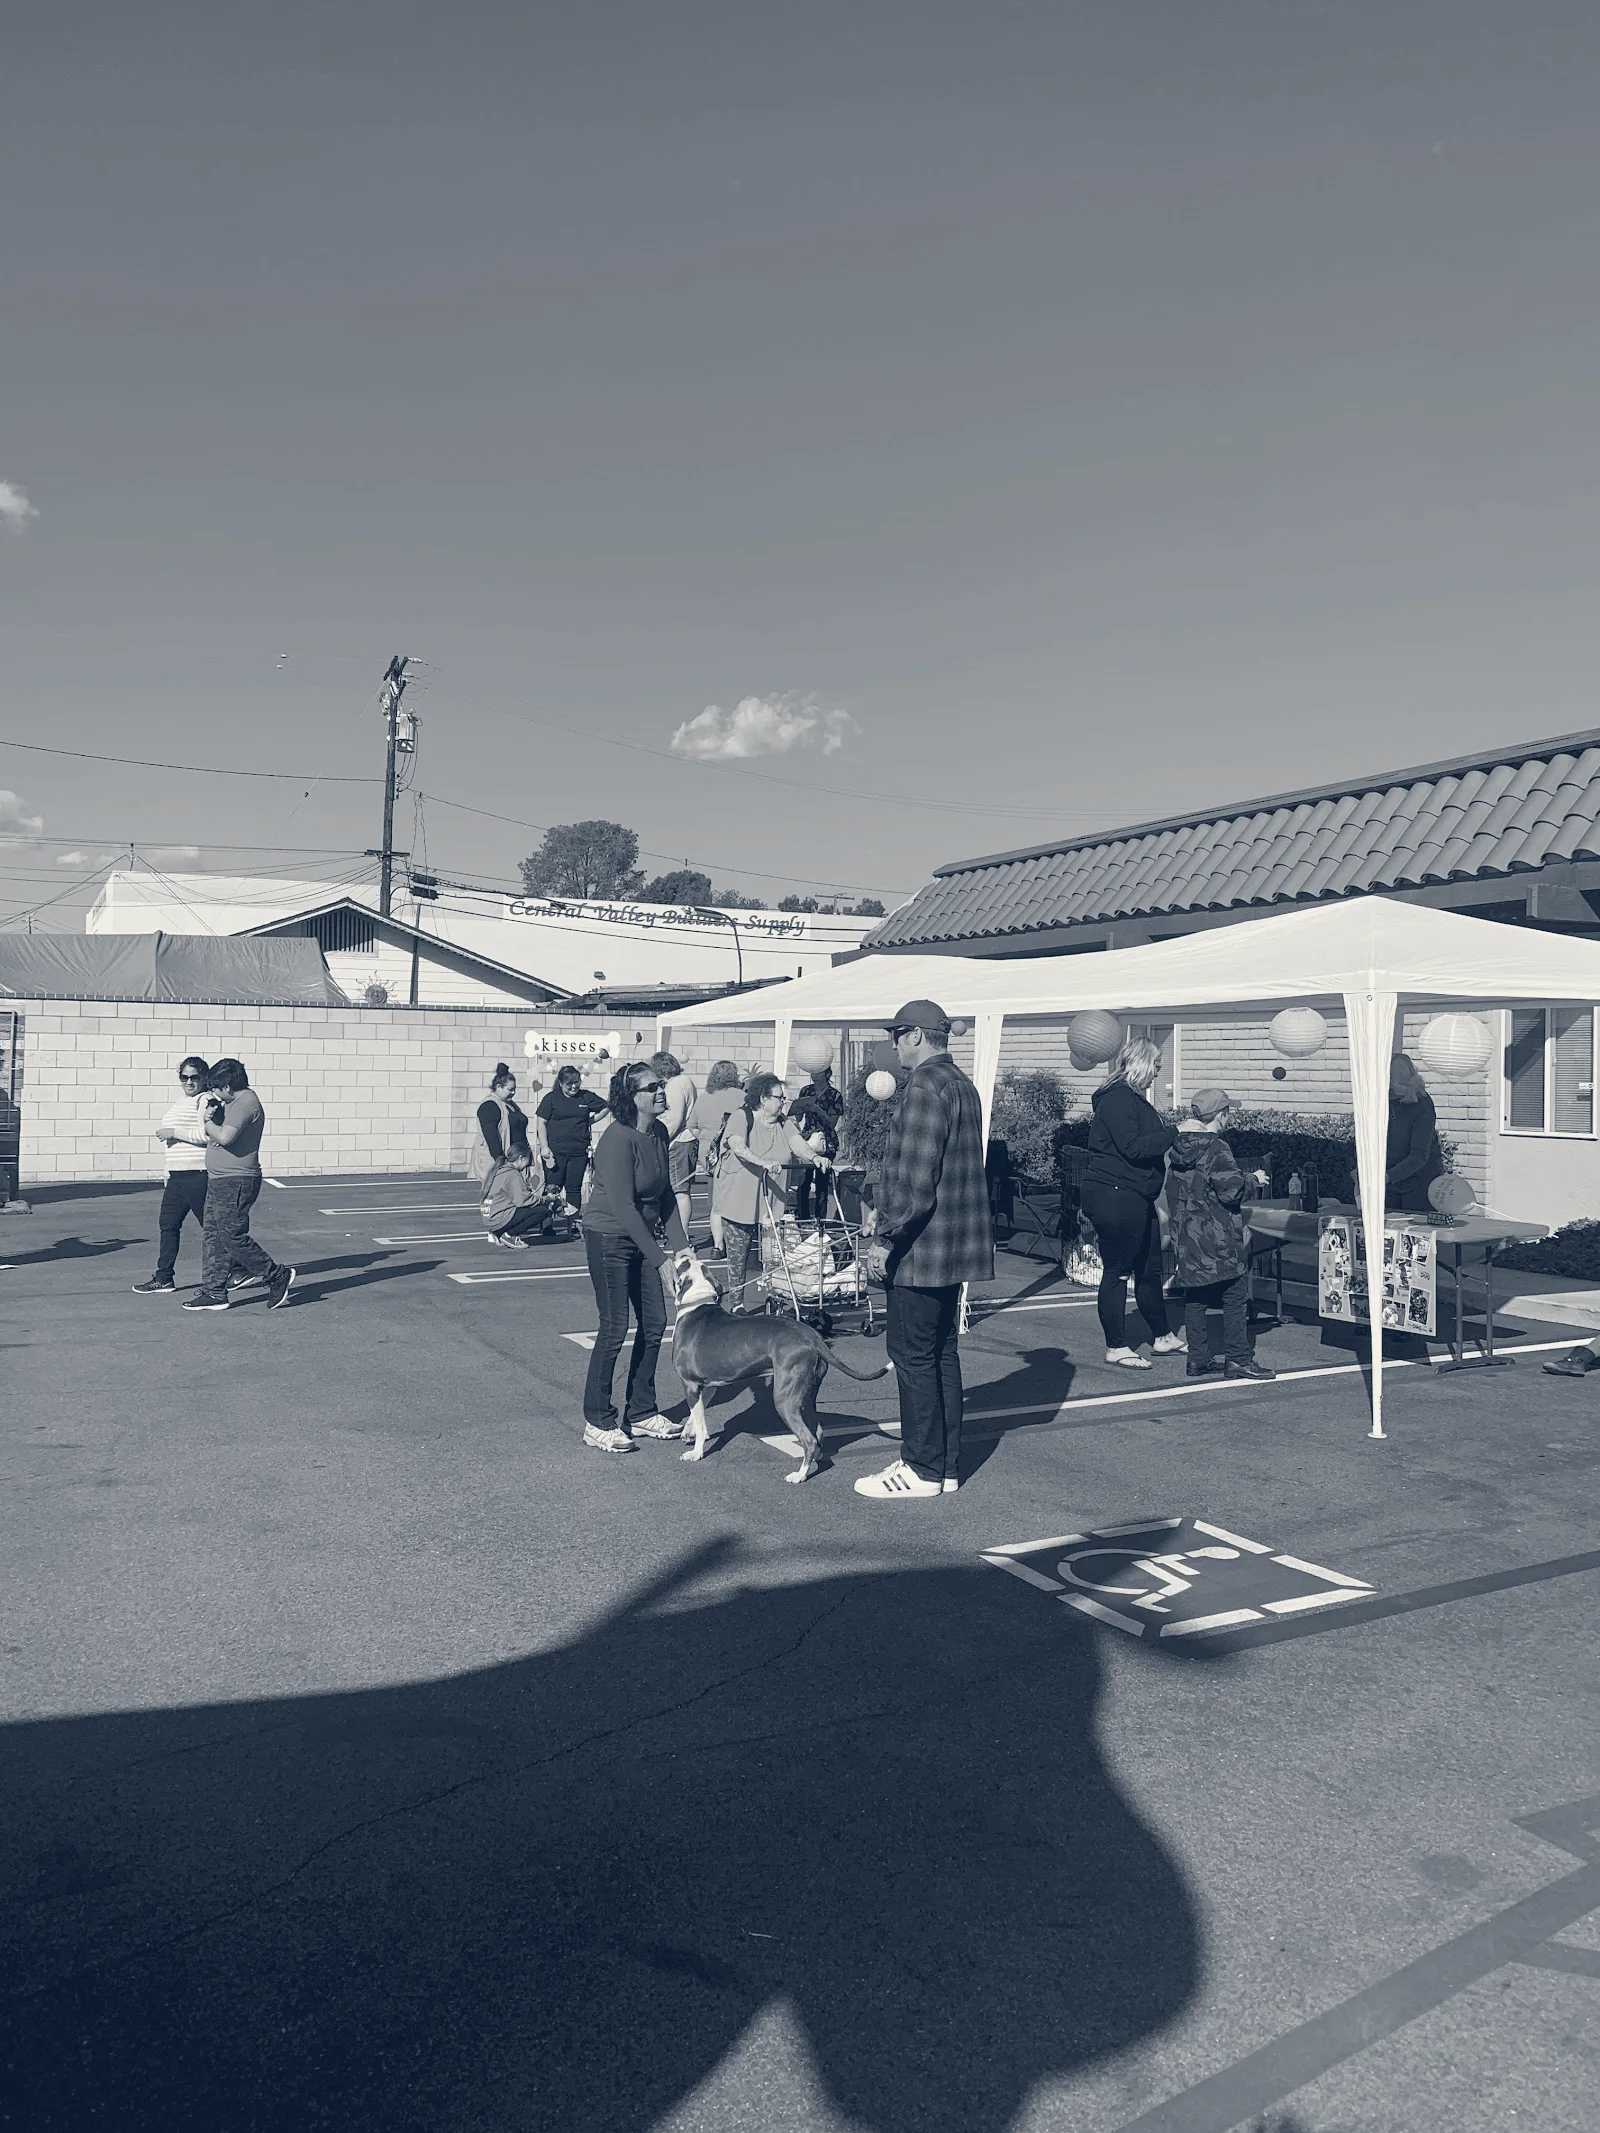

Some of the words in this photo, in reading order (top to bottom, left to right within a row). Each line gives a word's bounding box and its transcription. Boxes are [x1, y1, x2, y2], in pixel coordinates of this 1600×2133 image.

[509, 900, 588, 918] Central
[593, 904, 657, 928] Valley
[744, 915, 805, 936] Supply
[541, 1037, 596, 1052] kisses
